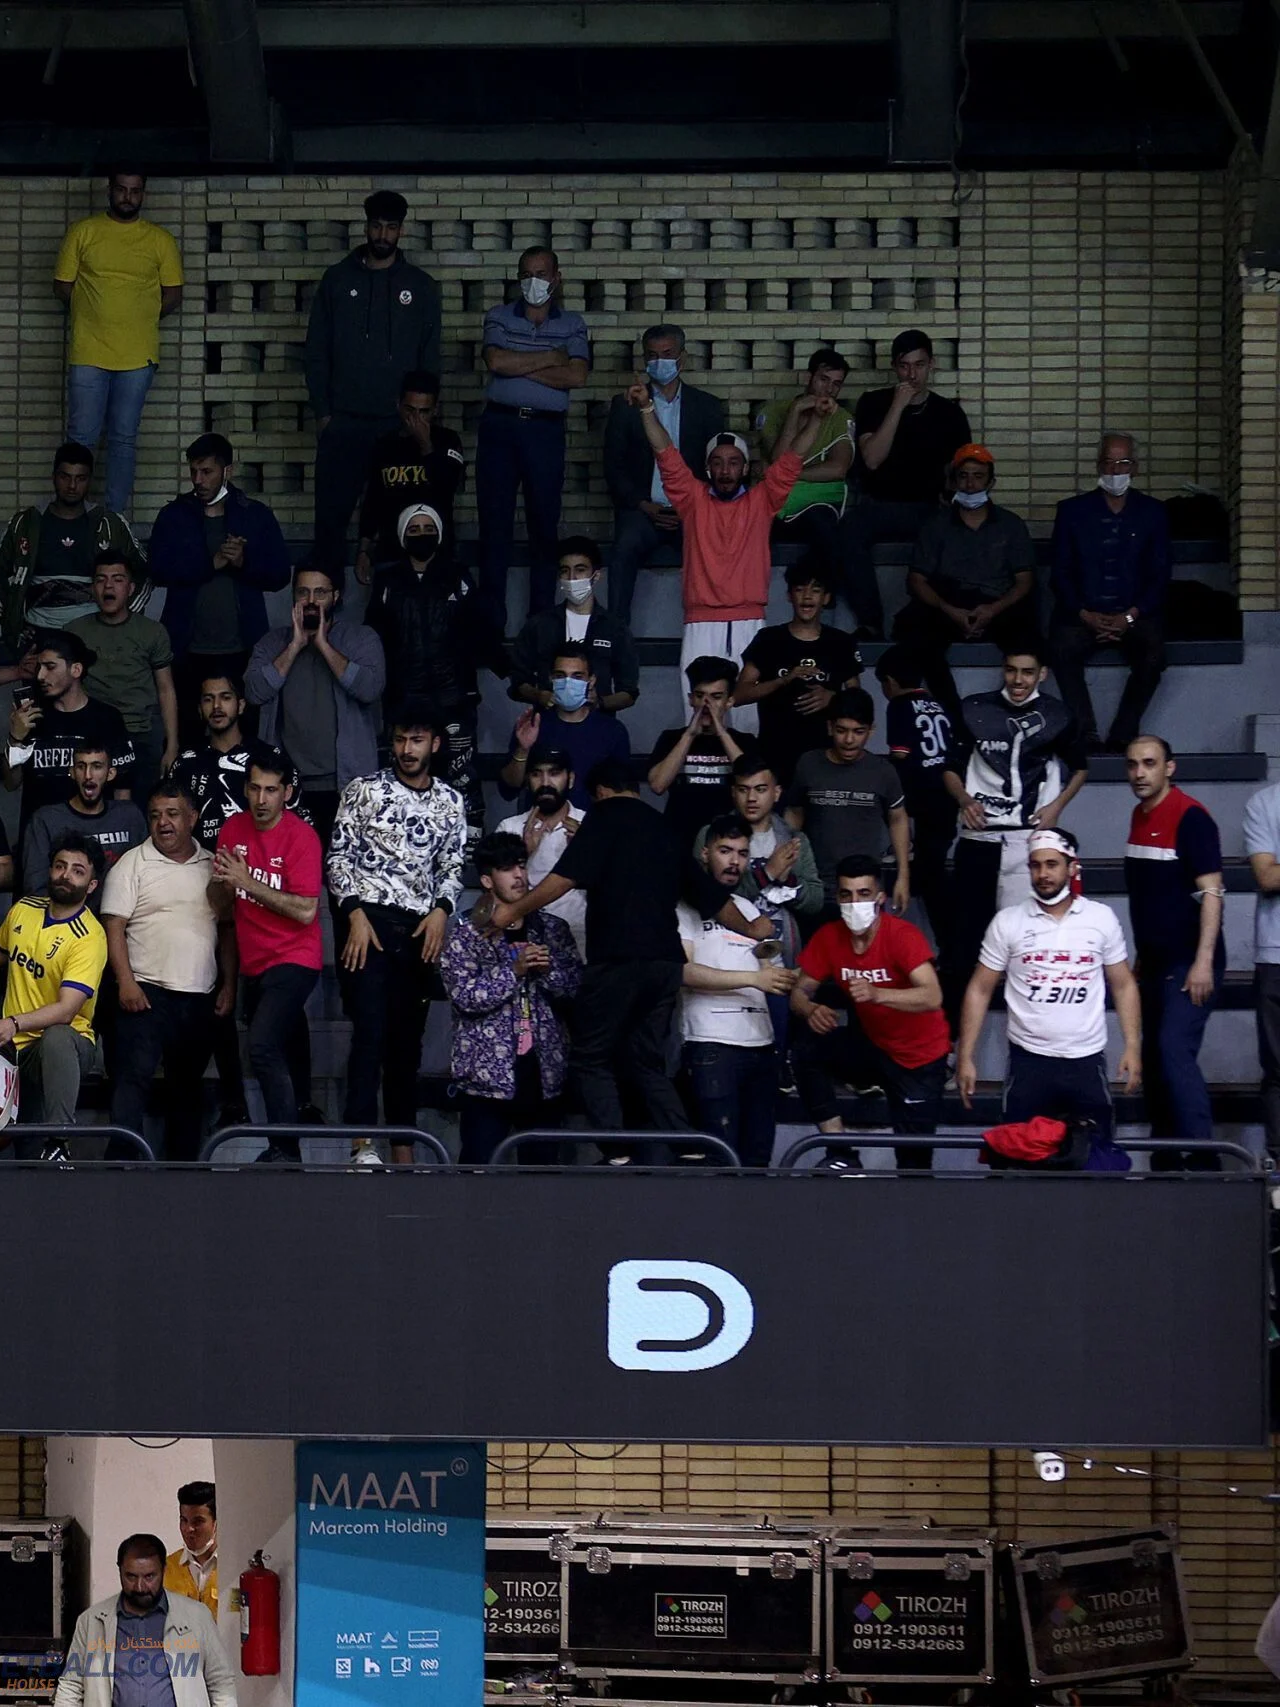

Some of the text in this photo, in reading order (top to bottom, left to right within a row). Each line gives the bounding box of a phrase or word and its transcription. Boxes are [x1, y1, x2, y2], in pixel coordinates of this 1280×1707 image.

[825, 790, 851, 799] BEST
[9, 945, 45, 980] Jeep
[841, 967, 893, 983] DIESEL
[309, 1471, 448, 1511] MAAT
[309, 1519, 448, 1537] Marcom Holding
[502, 1581, 561, 1597] TIROZ
[680, 1600, 724, 1612] TIROZH
[895, 1596, 967, 1614] TIROZH
[1088, 1586, 1161, 1611] TIROZH
[657, 1616, 724, 1625] 0912-1903611
[1052, 1615, 1161, 1640] 0912-1903611
[657, 1624, 725, 1634] 0912-5342663
[853, 1623, 965, 1636] 0912-1903611
[336, 1632, 373, 1644] MAAT
[852, 1638, 966, 1651] 0912-5342663
[1052, 1629, 1165, 1655] 0912-5342663
